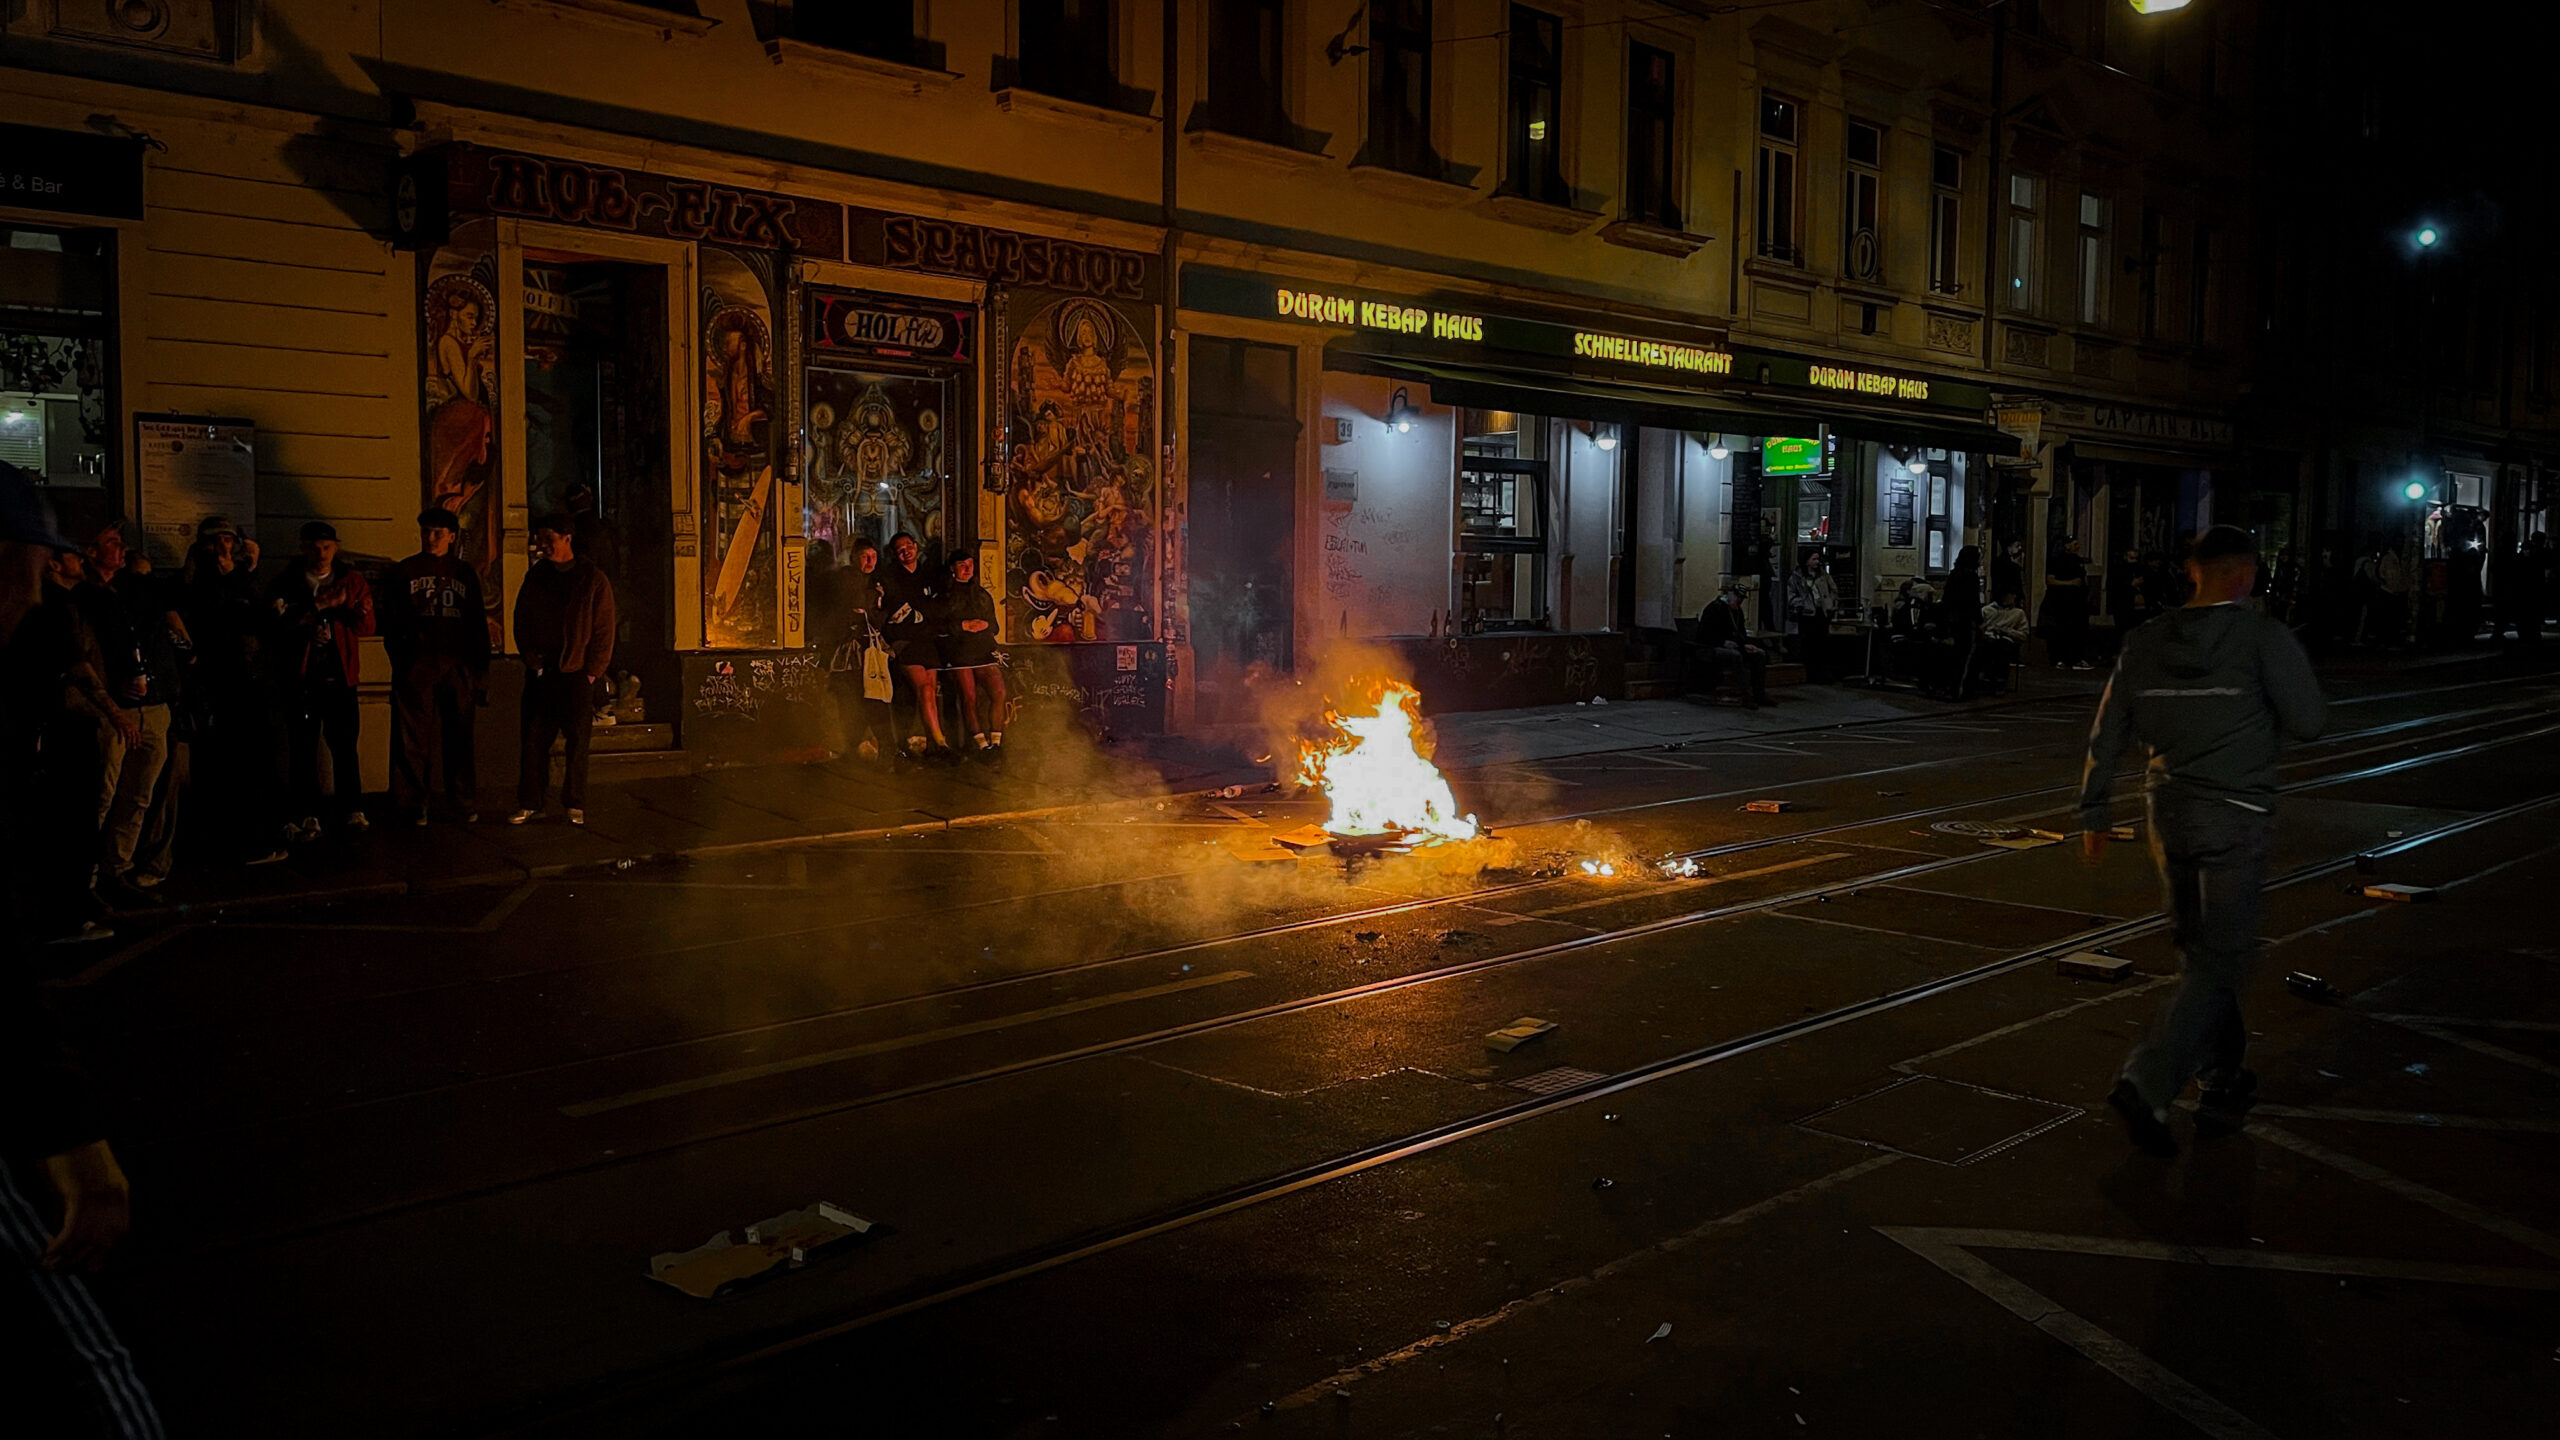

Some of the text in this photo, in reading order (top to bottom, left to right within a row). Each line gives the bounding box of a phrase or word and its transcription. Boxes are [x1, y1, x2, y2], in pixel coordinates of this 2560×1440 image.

[32, 176, 63, 194] Bar
[1277, 289, 1483, 341] DÜRÜM KEBAP HAUS
[1574, 332, 1733, 374] SCHNELLRESTAURANT
[1857, 372, 1896, 396] KEBAP
[1898, 378, 1928, 400] HAUS
[1340, 422, 1352, 438] 39
